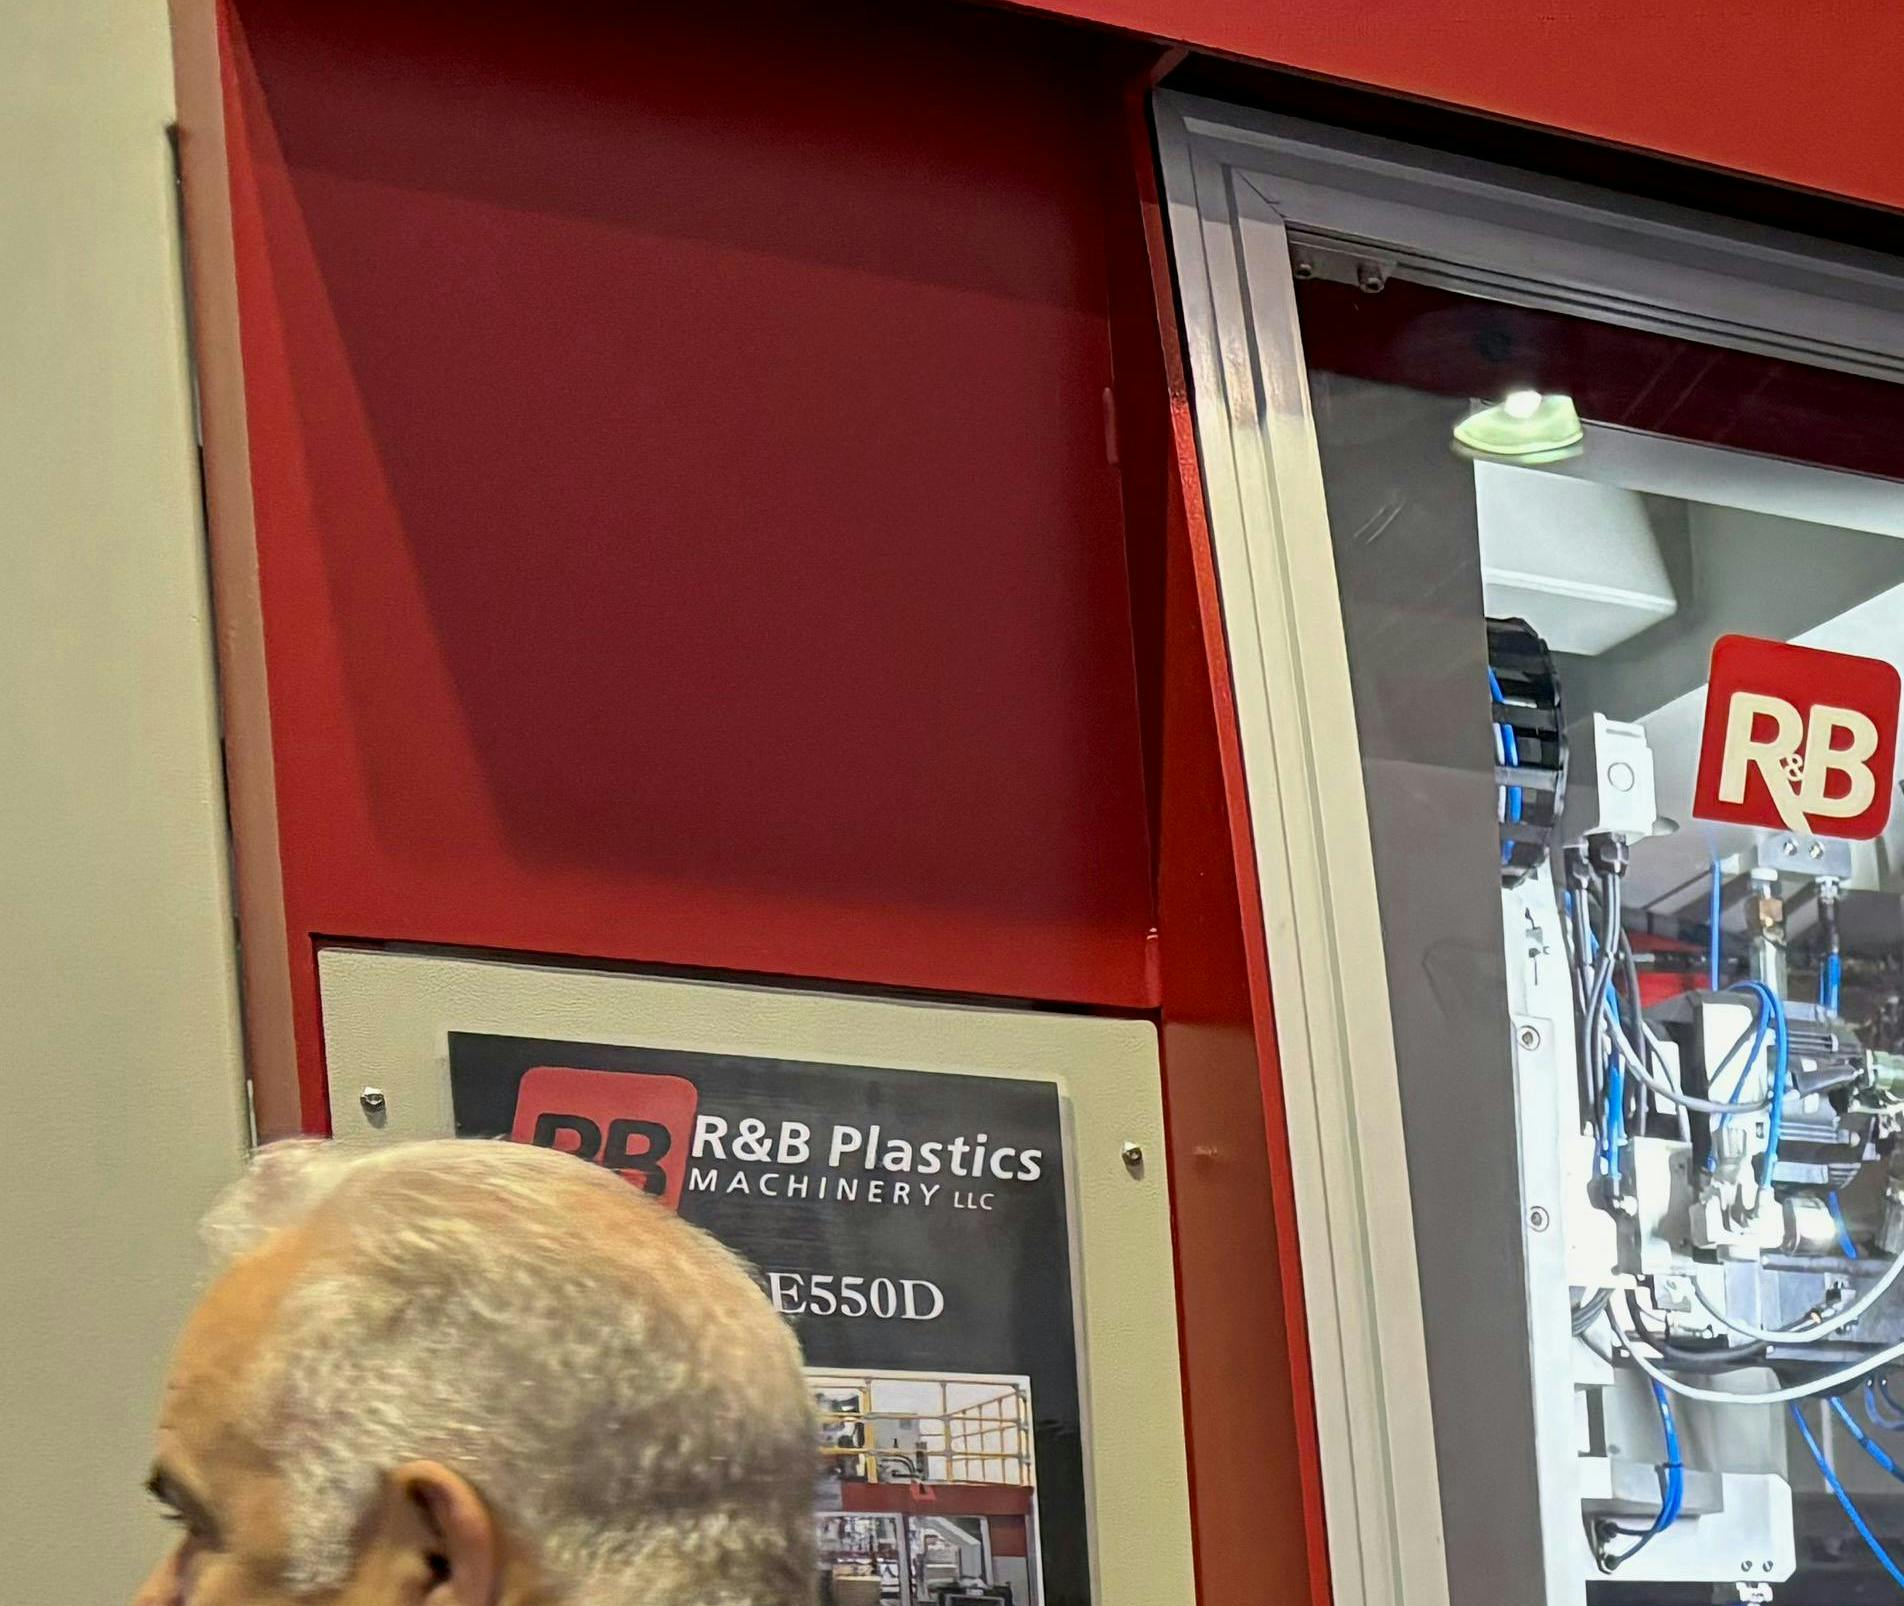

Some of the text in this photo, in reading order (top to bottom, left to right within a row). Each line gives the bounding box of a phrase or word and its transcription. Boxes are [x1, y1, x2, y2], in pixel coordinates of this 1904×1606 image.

[1718, 691, 1879, 835] R&B
[690, 1114, 1043, 1182] R&B Plastics
[688, 1167, 995, 1211] MACHINERY LLC
